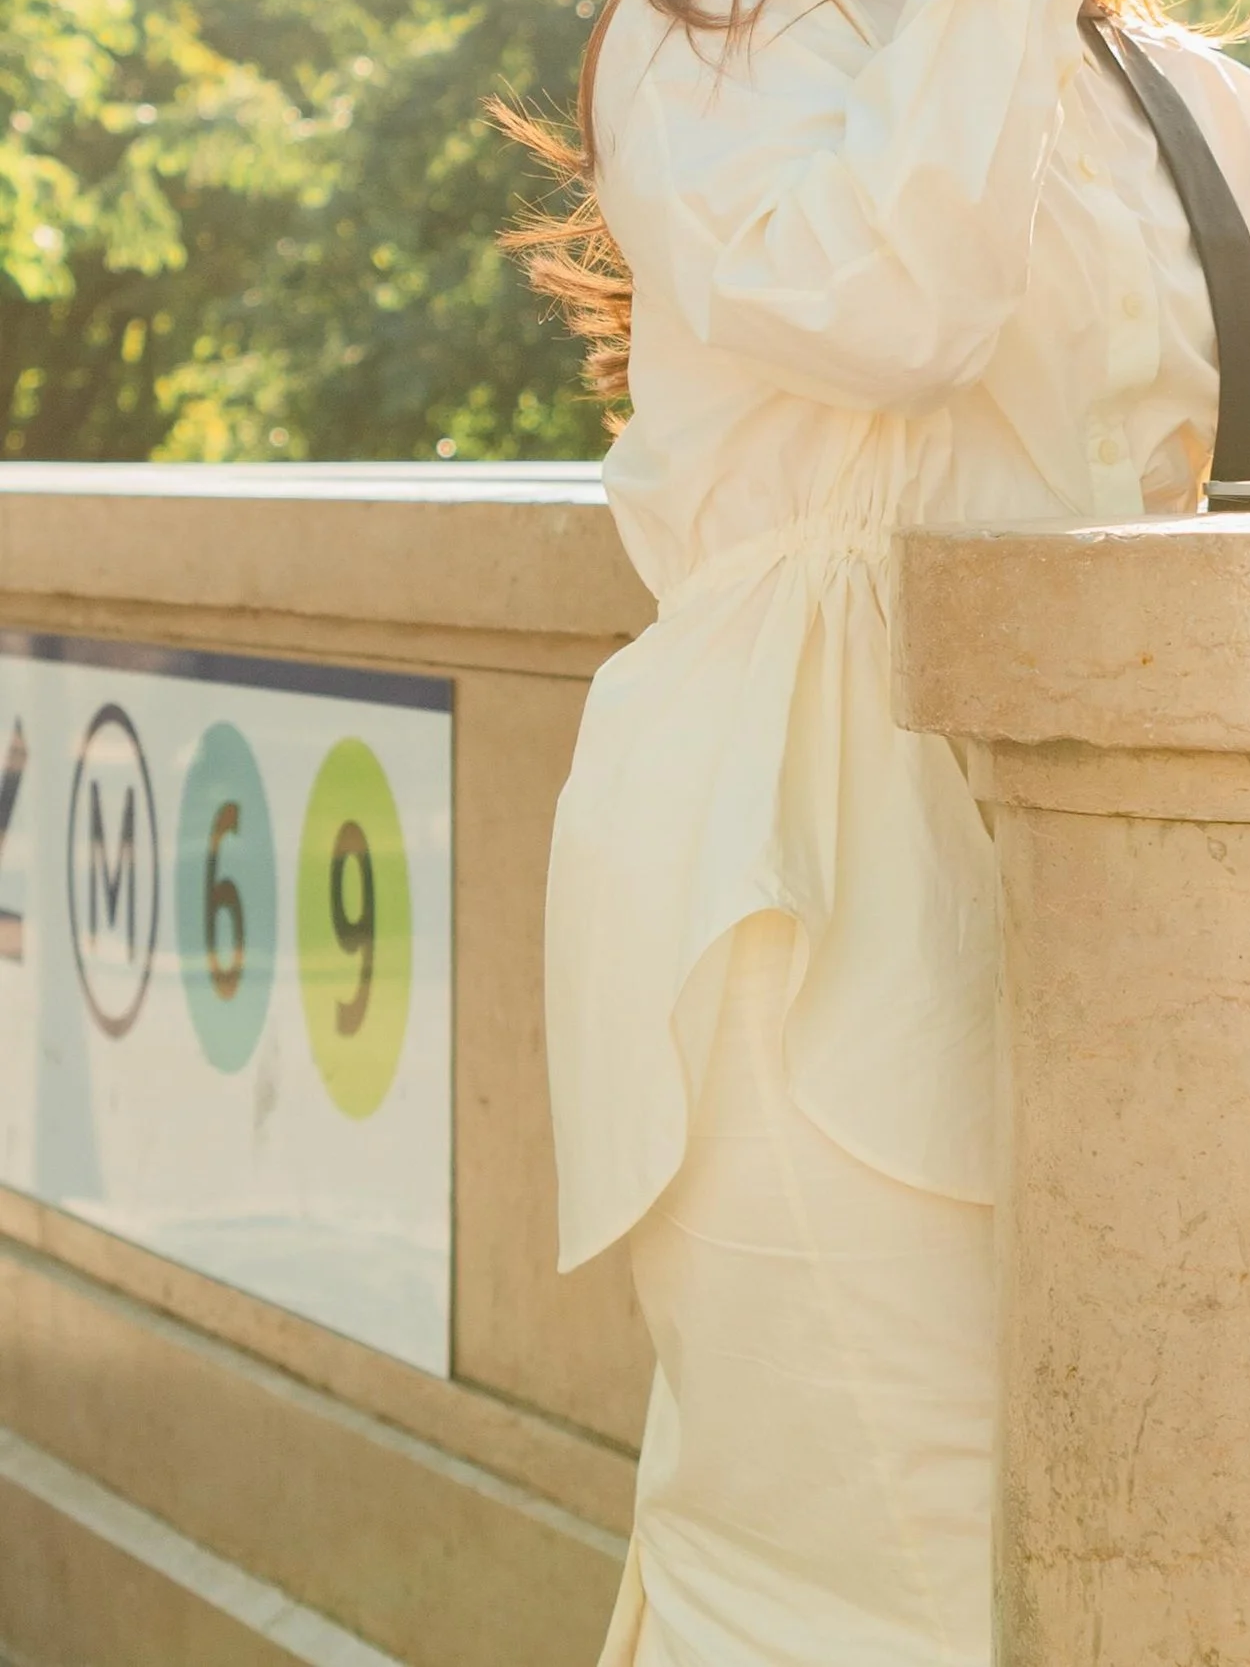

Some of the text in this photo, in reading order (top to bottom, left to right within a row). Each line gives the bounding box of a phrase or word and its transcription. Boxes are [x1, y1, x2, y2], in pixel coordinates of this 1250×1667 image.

[89, 779, 376, 1038] M 6 9
